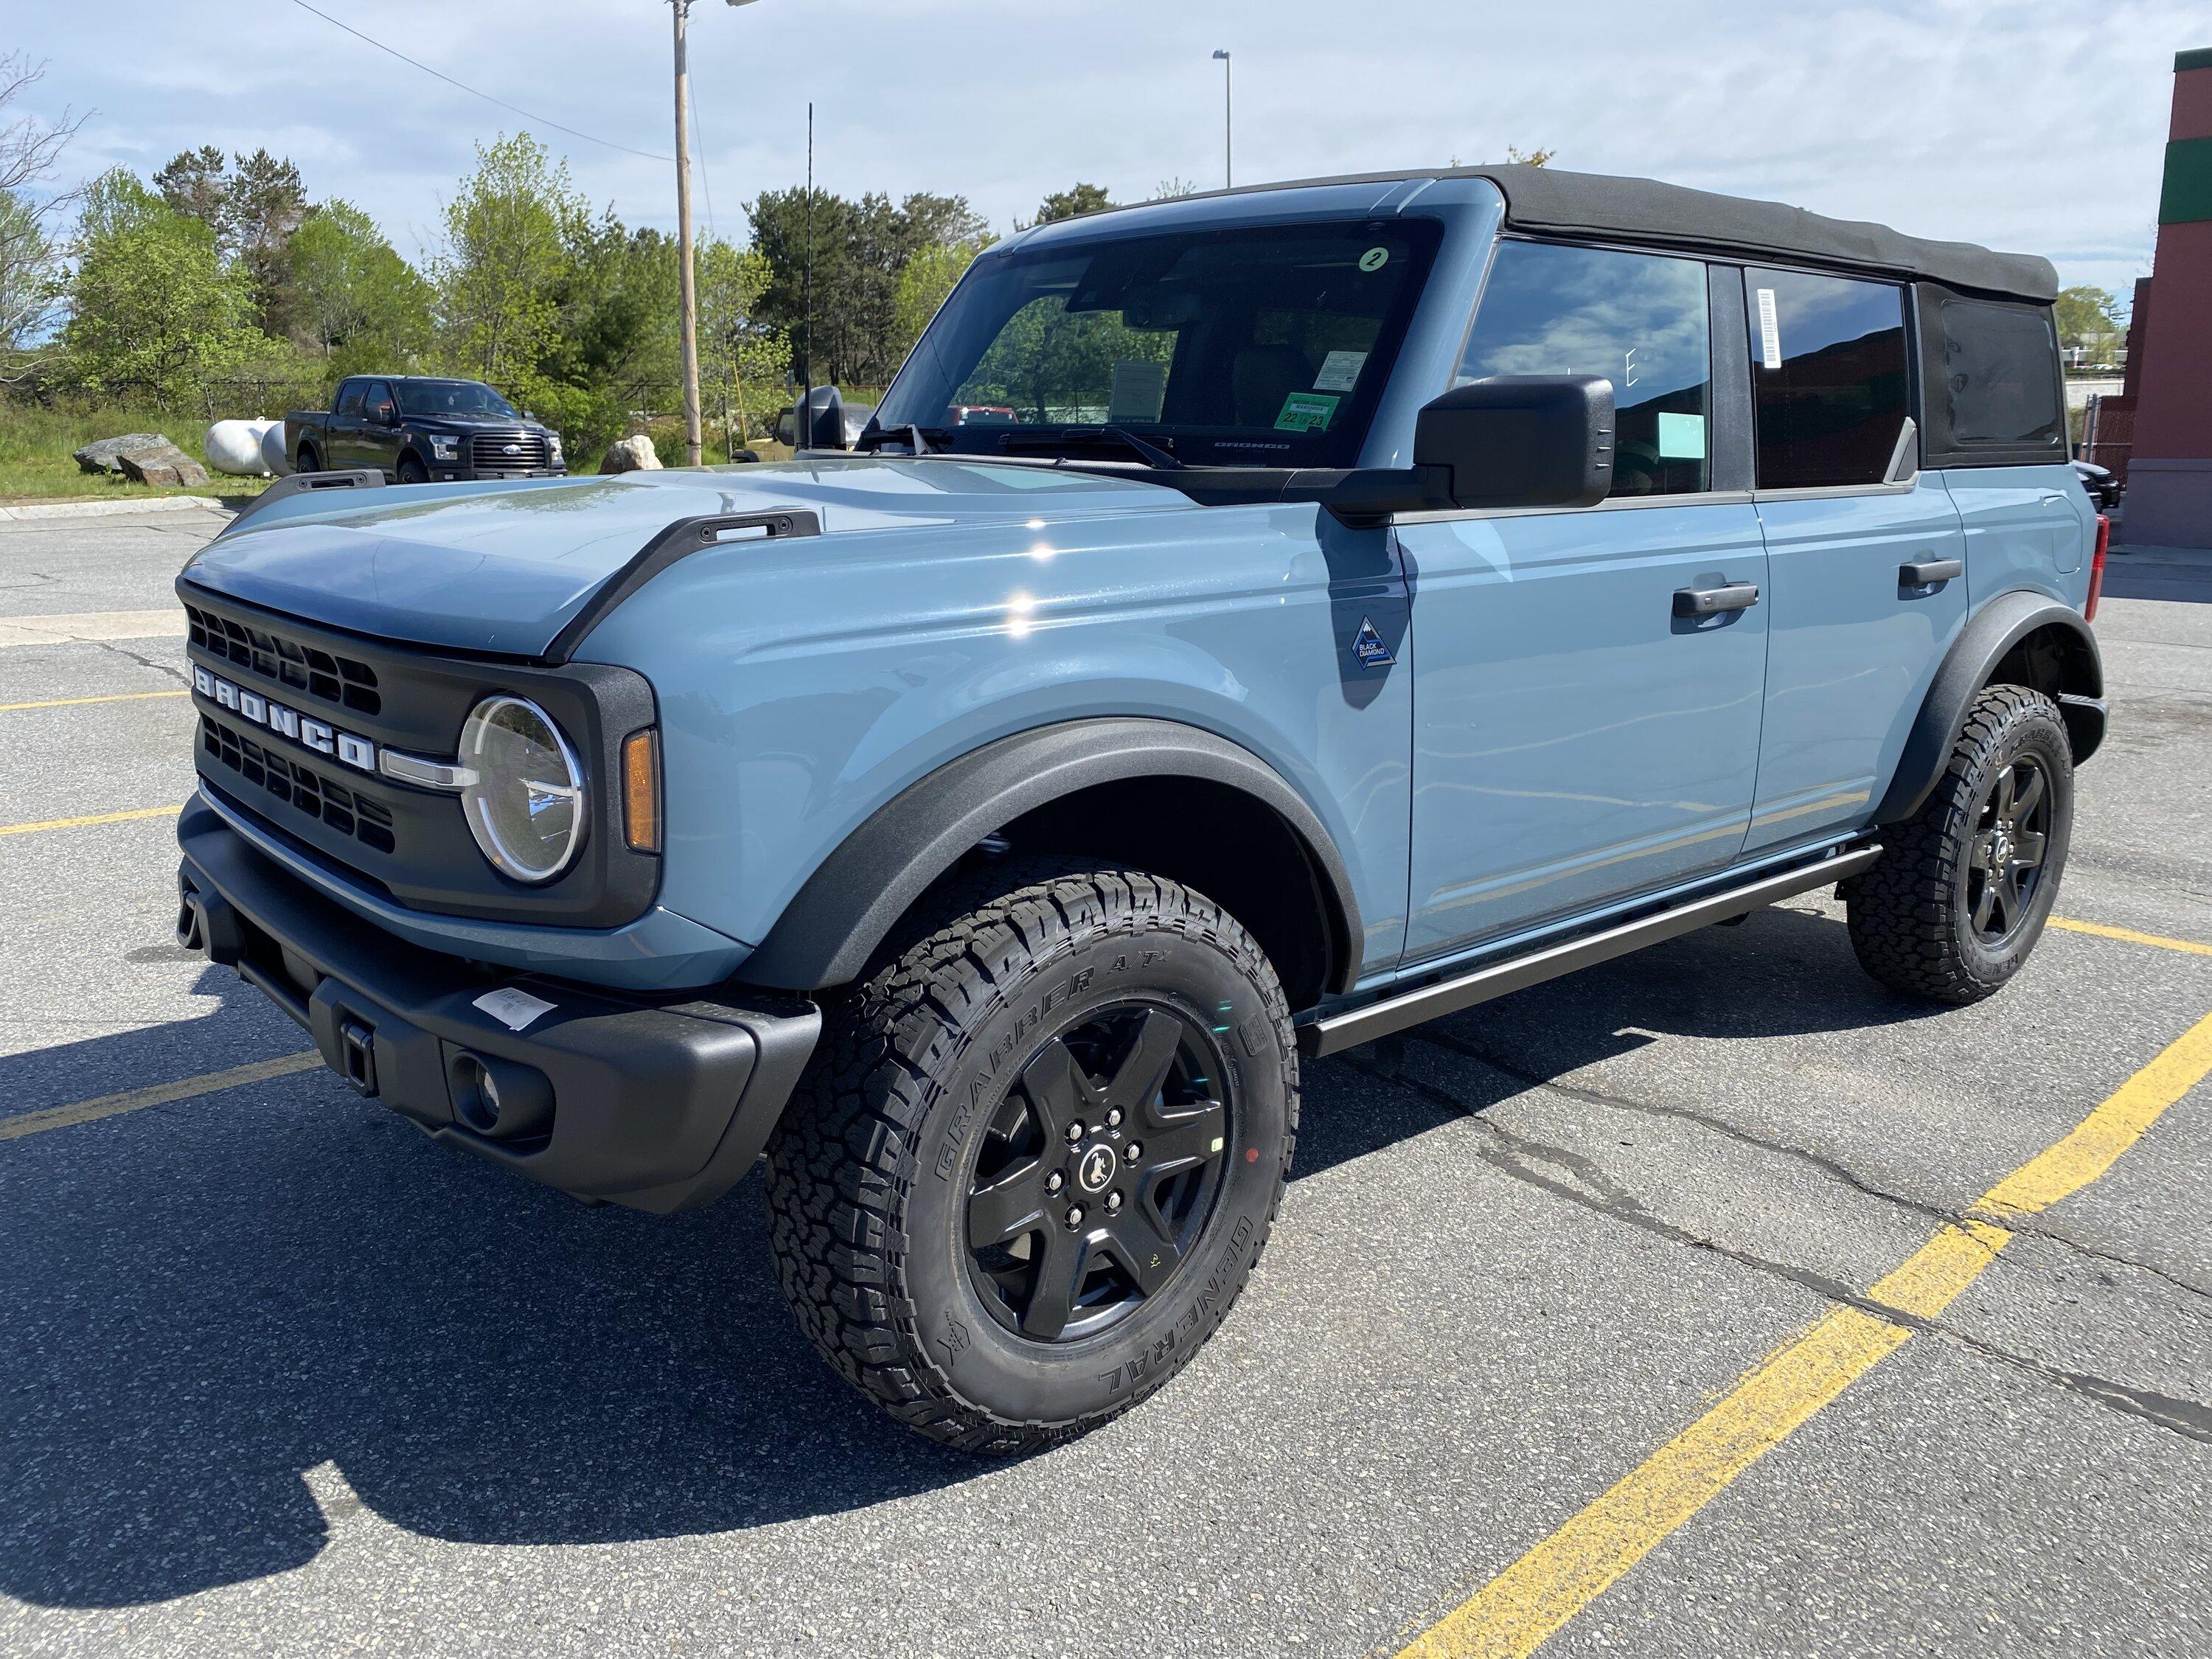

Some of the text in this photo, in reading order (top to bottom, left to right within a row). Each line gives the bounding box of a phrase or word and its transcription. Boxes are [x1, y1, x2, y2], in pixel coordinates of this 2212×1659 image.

[1366, 251, 1382, 266] 2
[1625, 347, 1639, 387] E
[1282, 412, 1324, 425] 22 23
[1360, 648, 1385, 657] DIAMOND
[194, 665, 375, 771] BRONCO
[934, 965, 1096, 1182] GRABBER
[1099, 1214, 1253, 1395] GENERAL
